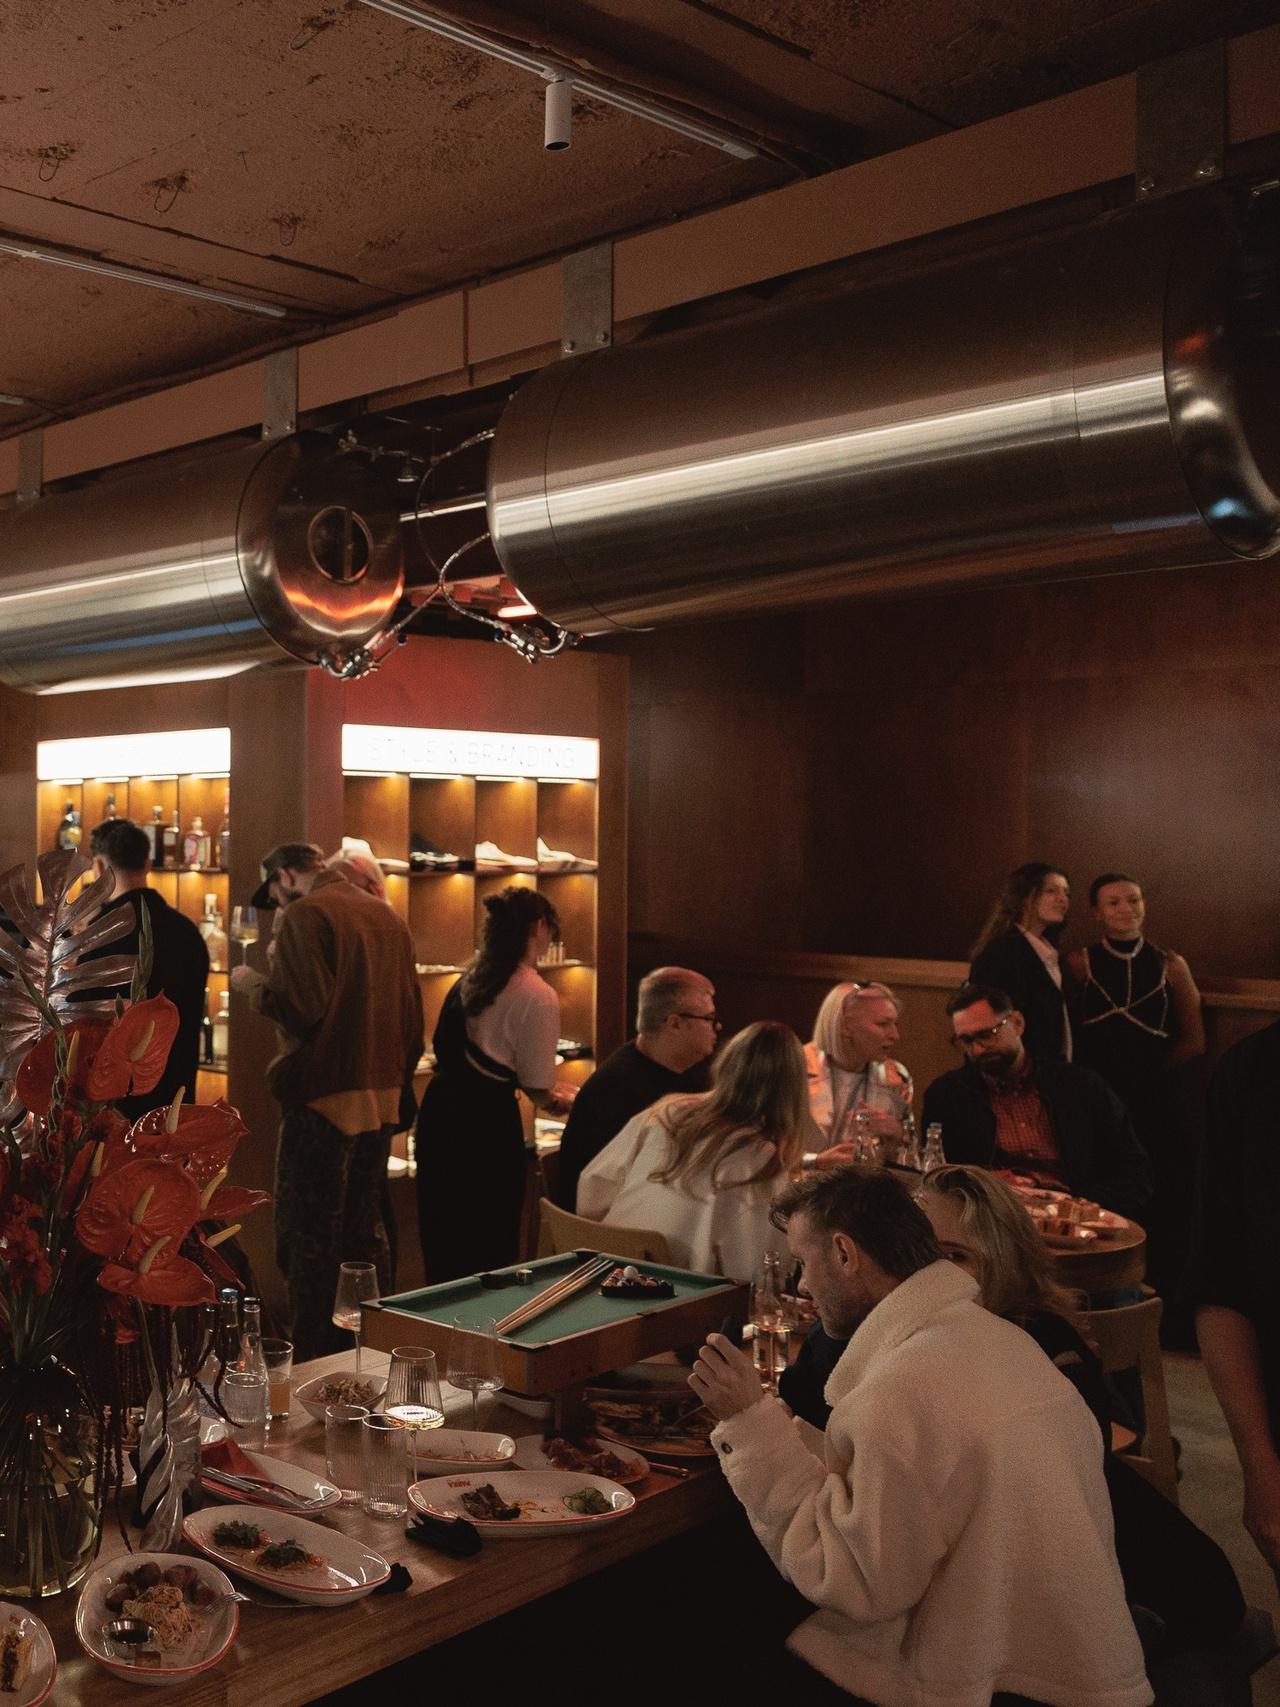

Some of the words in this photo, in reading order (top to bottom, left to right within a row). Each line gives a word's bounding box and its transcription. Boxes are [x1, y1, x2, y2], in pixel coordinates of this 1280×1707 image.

[368, 737, 440, 764] STYLE
[446, 740, 459, 764] &
[467, 742, 577, 770] BRANDING
